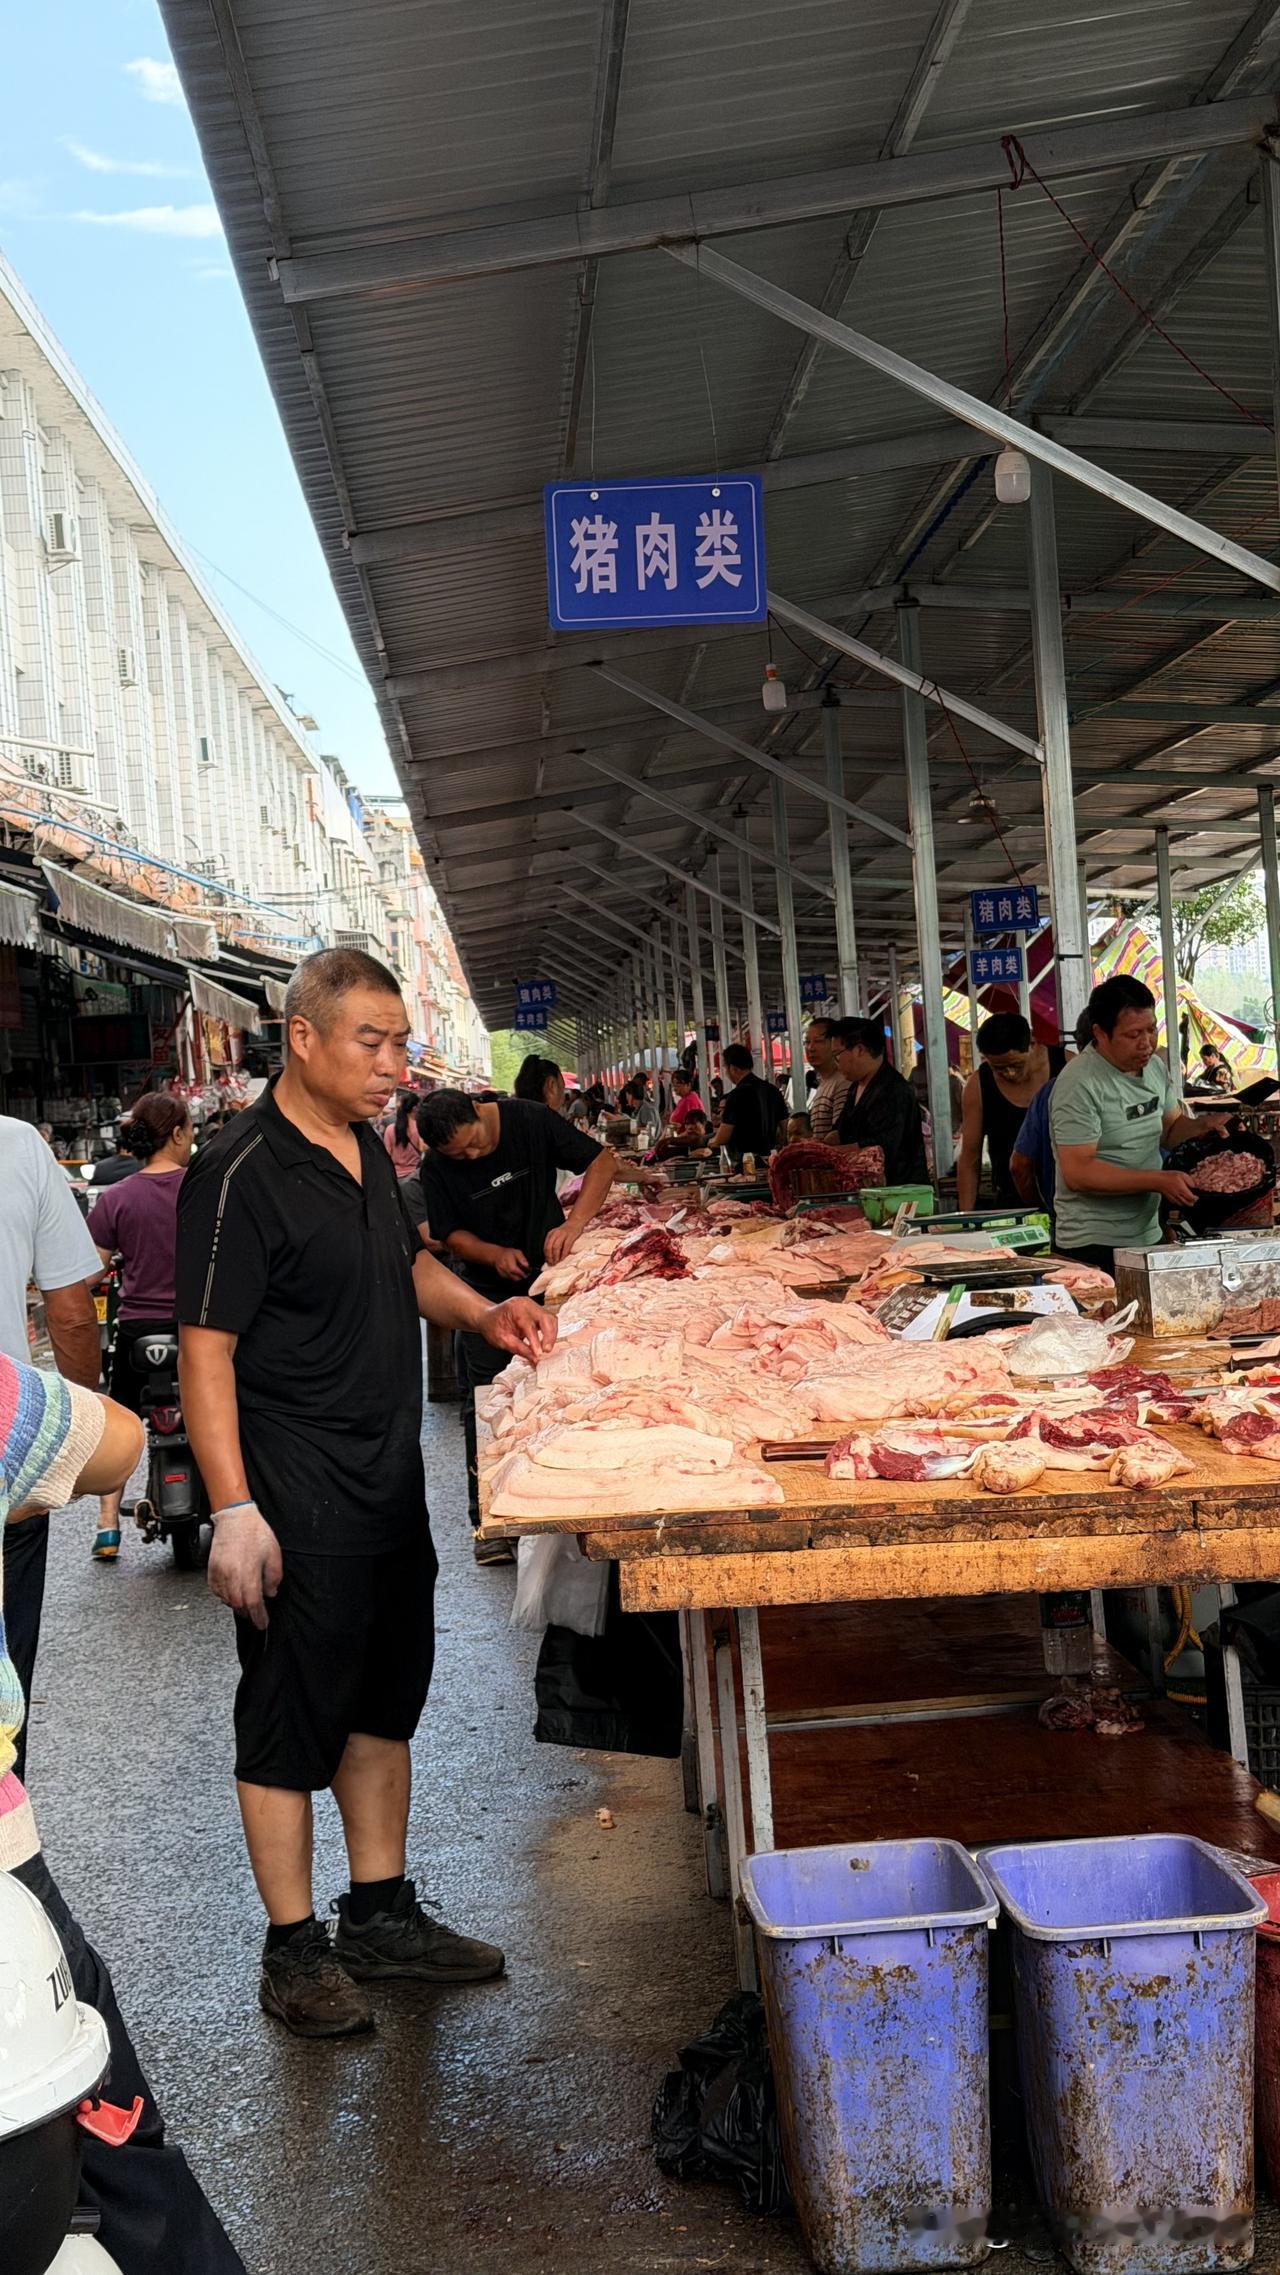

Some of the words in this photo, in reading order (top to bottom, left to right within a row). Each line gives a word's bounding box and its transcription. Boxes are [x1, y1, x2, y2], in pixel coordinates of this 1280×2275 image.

[569, 509, 743, 594] 猪肉类
[979, 896, 1032, 923] 猪肉类
[976, 955, 1018, 977] 羊肉类
